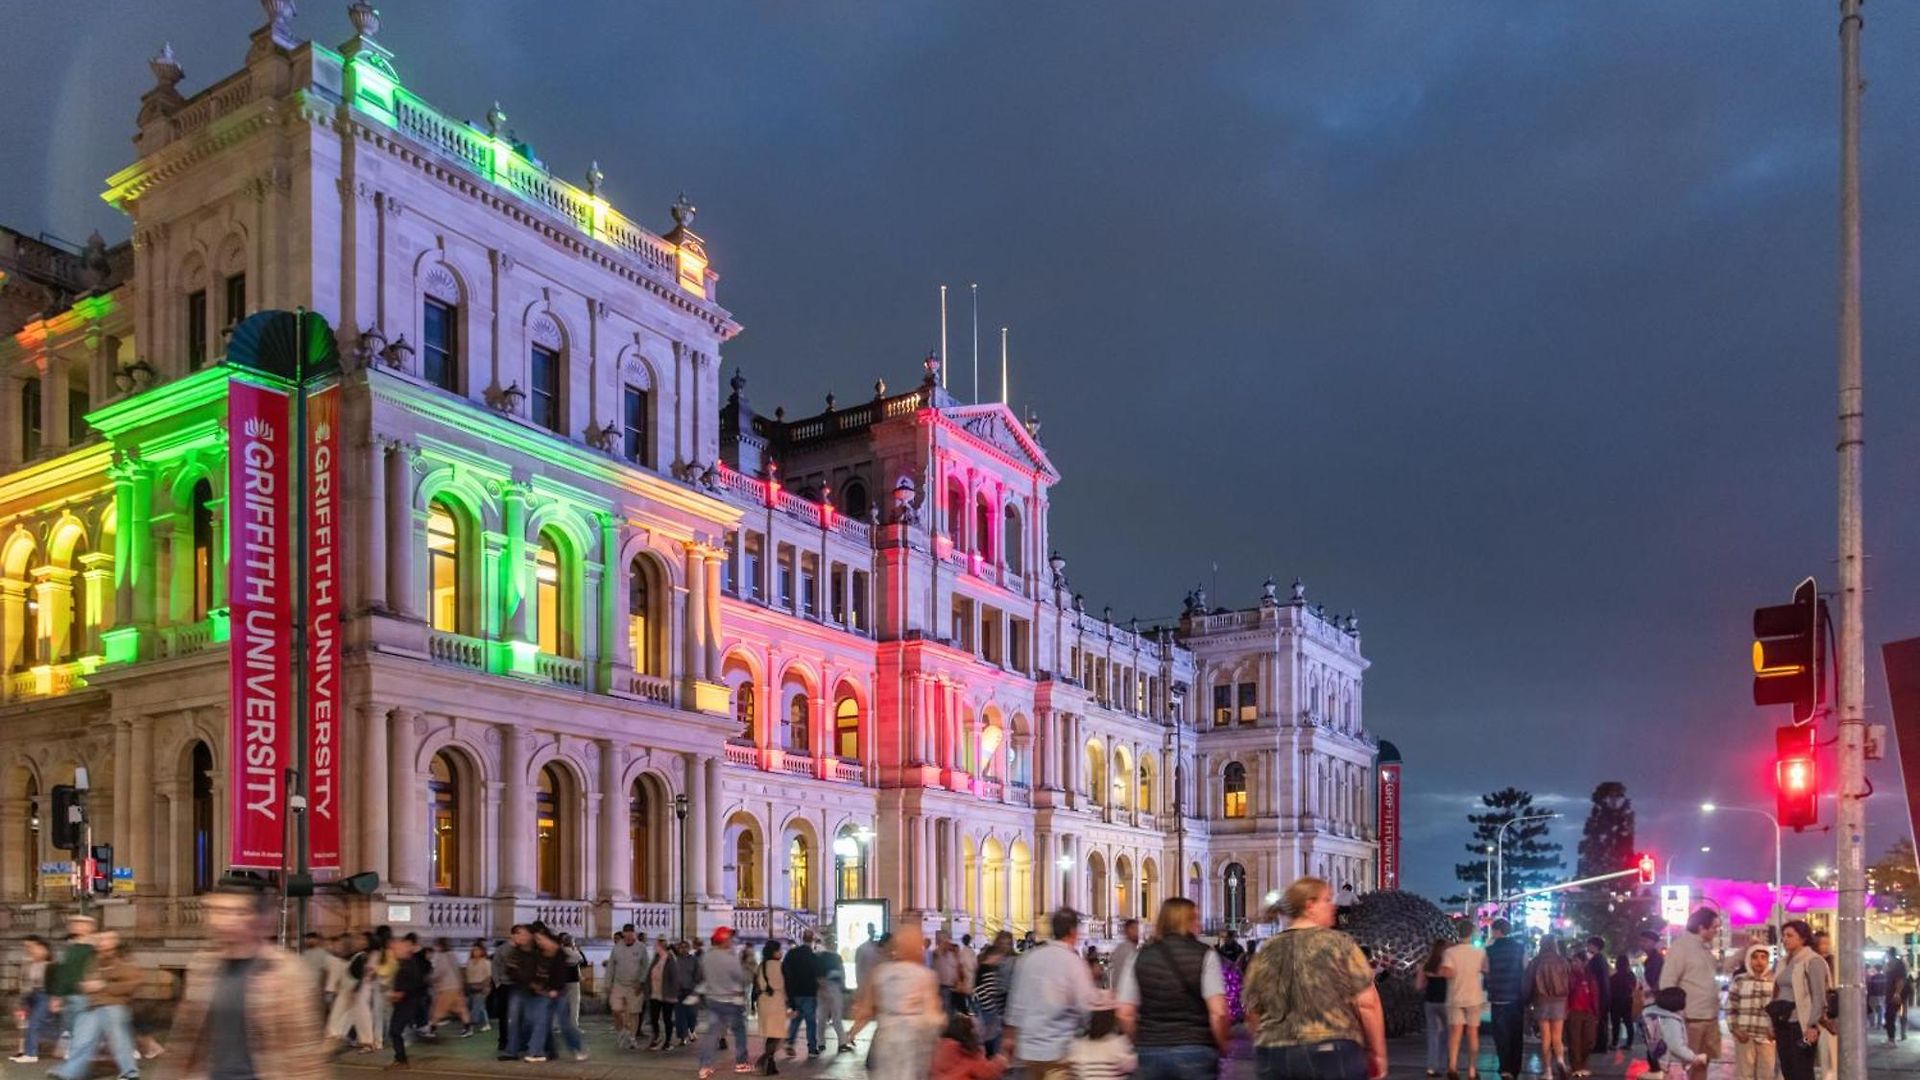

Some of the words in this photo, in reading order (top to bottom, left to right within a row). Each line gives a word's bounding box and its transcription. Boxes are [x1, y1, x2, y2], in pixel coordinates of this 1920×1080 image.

[244, 441, 275, 605] GRIFFITH
[315, 445, 333, 606] GRIFFITH
[246, 608, 276, 821] UNIVERSITY
[315, 612, 332, 820] UNIVERSITY
